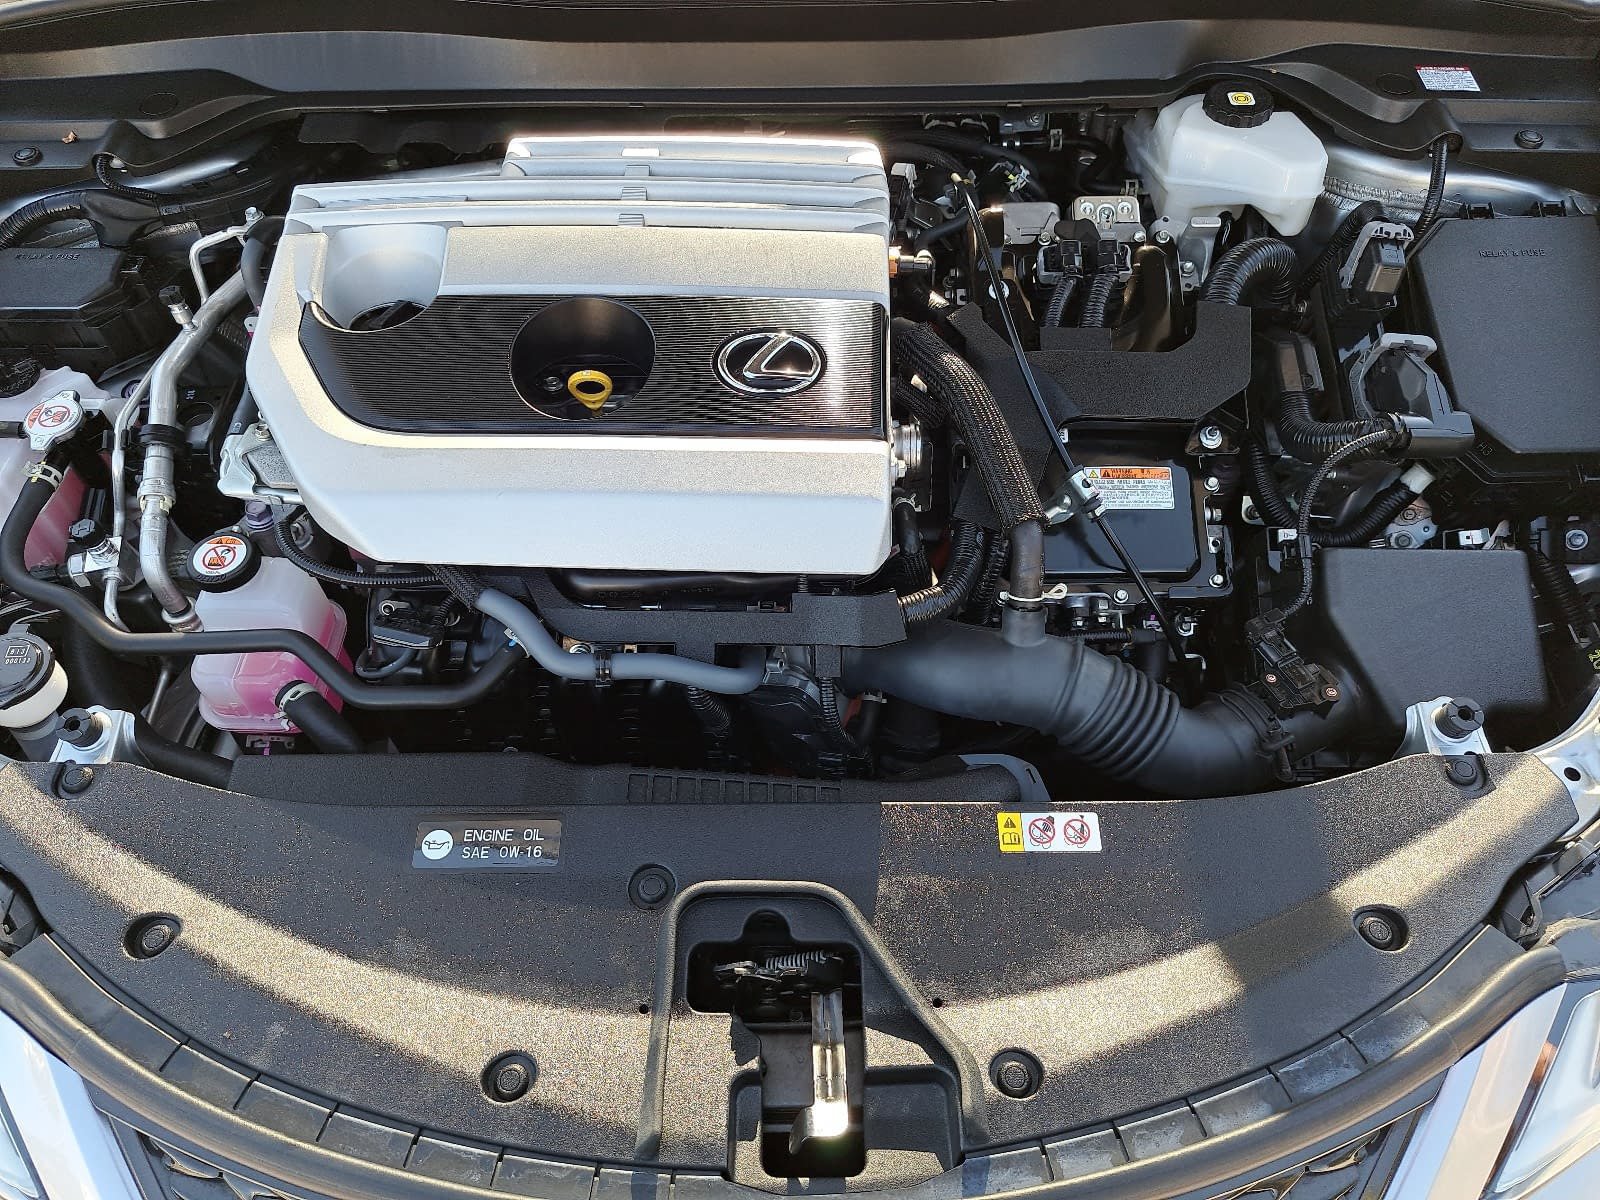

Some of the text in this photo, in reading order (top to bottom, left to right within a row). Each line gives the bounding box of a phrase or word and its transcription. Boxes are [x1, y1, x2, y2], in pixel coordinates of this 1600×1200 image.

[1478, 248, 1509, 258] RELAY
[1520, 248, 1546, 257] FUSE
[463, 829, 545, 842] ENGINE OIL
[461, 845, 542, 859] SAE 0W-16
